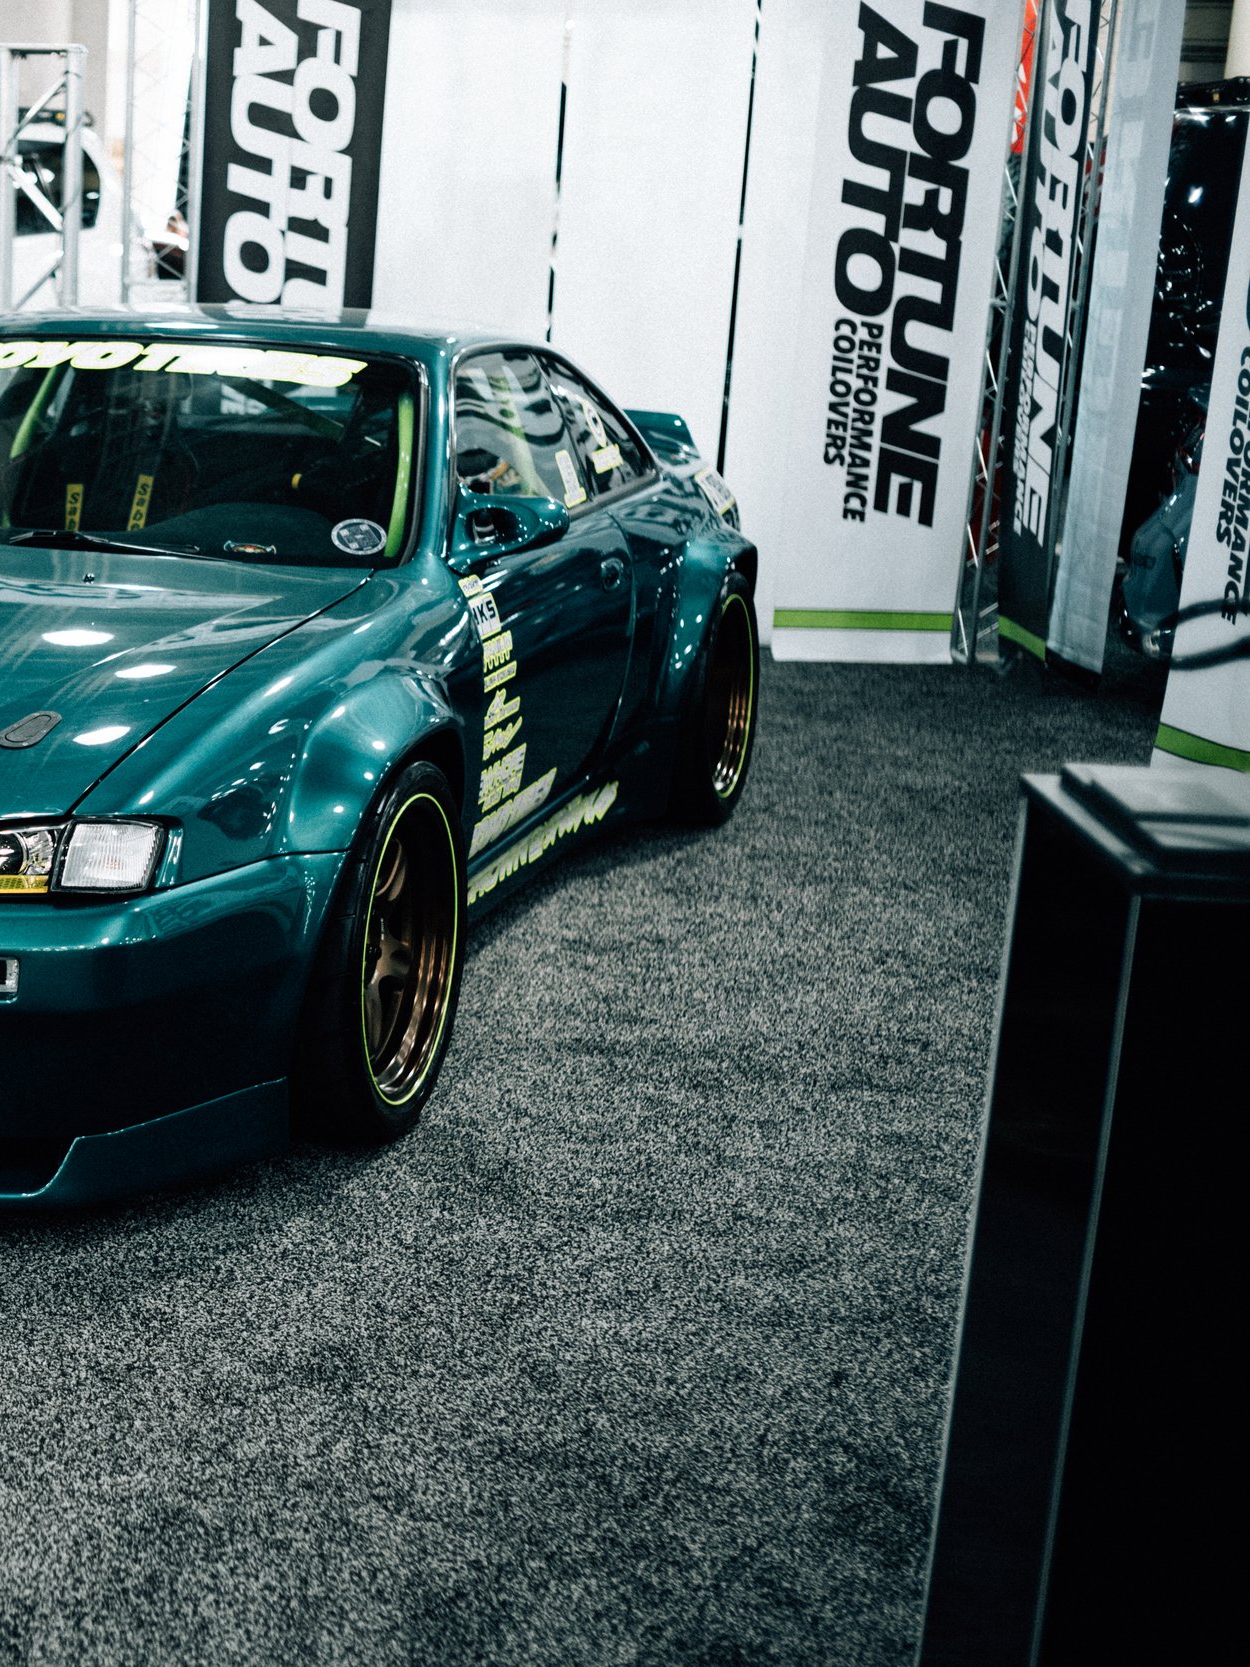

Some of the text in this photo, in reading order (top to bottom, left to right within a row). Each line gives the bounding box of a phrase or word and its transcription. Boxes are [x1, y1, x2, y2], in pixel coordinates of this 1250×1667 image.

[223, 0, 299, 304] AUTO
[280, 0, 362, 307] FORT
[834, 0, 919, 317] AUTO
[873, 0, 986, 529] FORTUNE
[1021, 0, 1091, 548] FORTUNE
[68, 492, 80, 531] Sab
[823, 318, 858, 468] COILOVERS
[842, 320, 884, 523] PERFORMANCE
